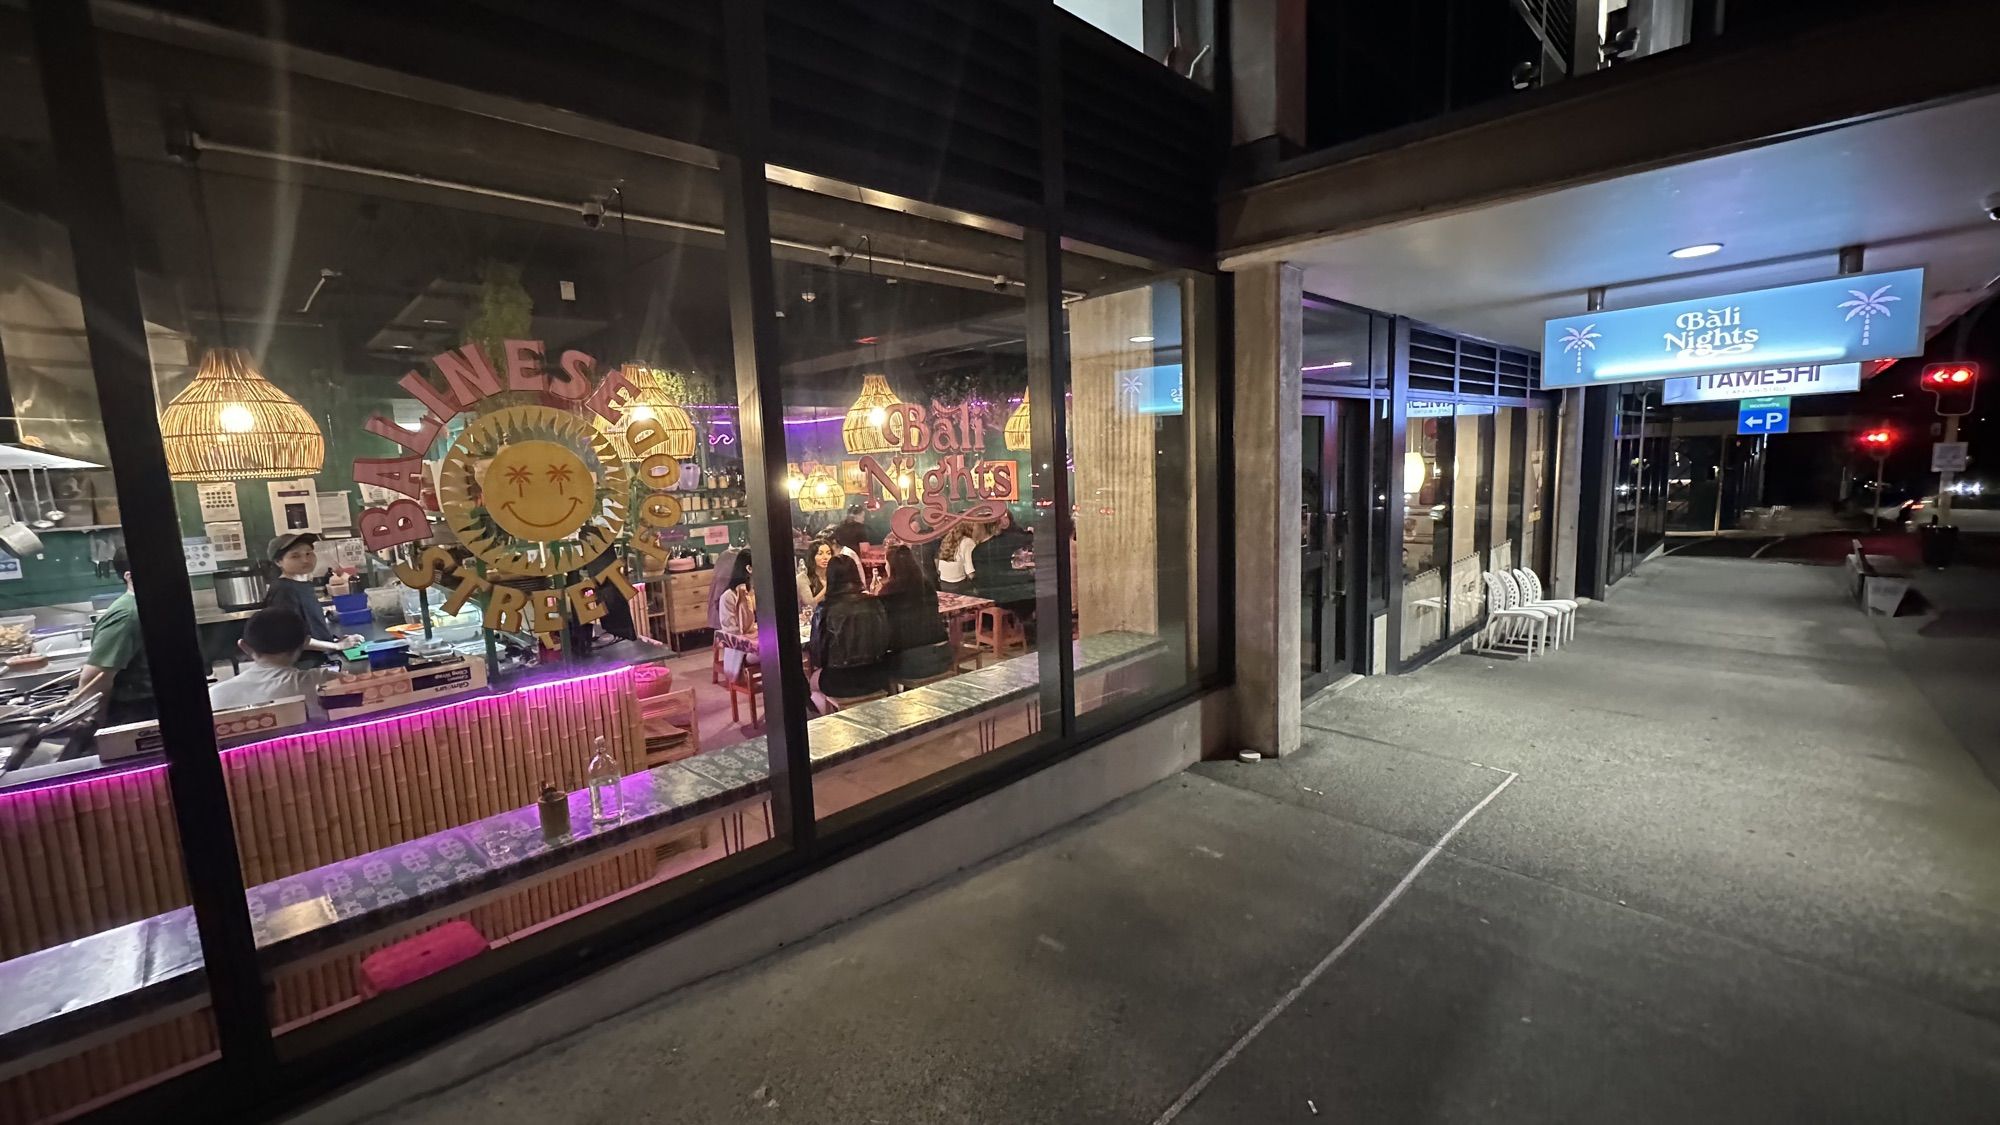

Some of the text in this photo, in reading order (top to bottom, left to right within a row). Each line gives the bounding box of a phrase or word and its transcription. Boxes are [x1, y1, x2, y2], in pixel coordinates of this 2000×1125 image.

[1663, 327, 1760, 360] Nights
[352, 340, 643, 551] BALINESE
[1765, 412, 1783, 430] P
[392, 417, 683, 633] STREET FOOD
[858, 454, 1013, 544] Nights
